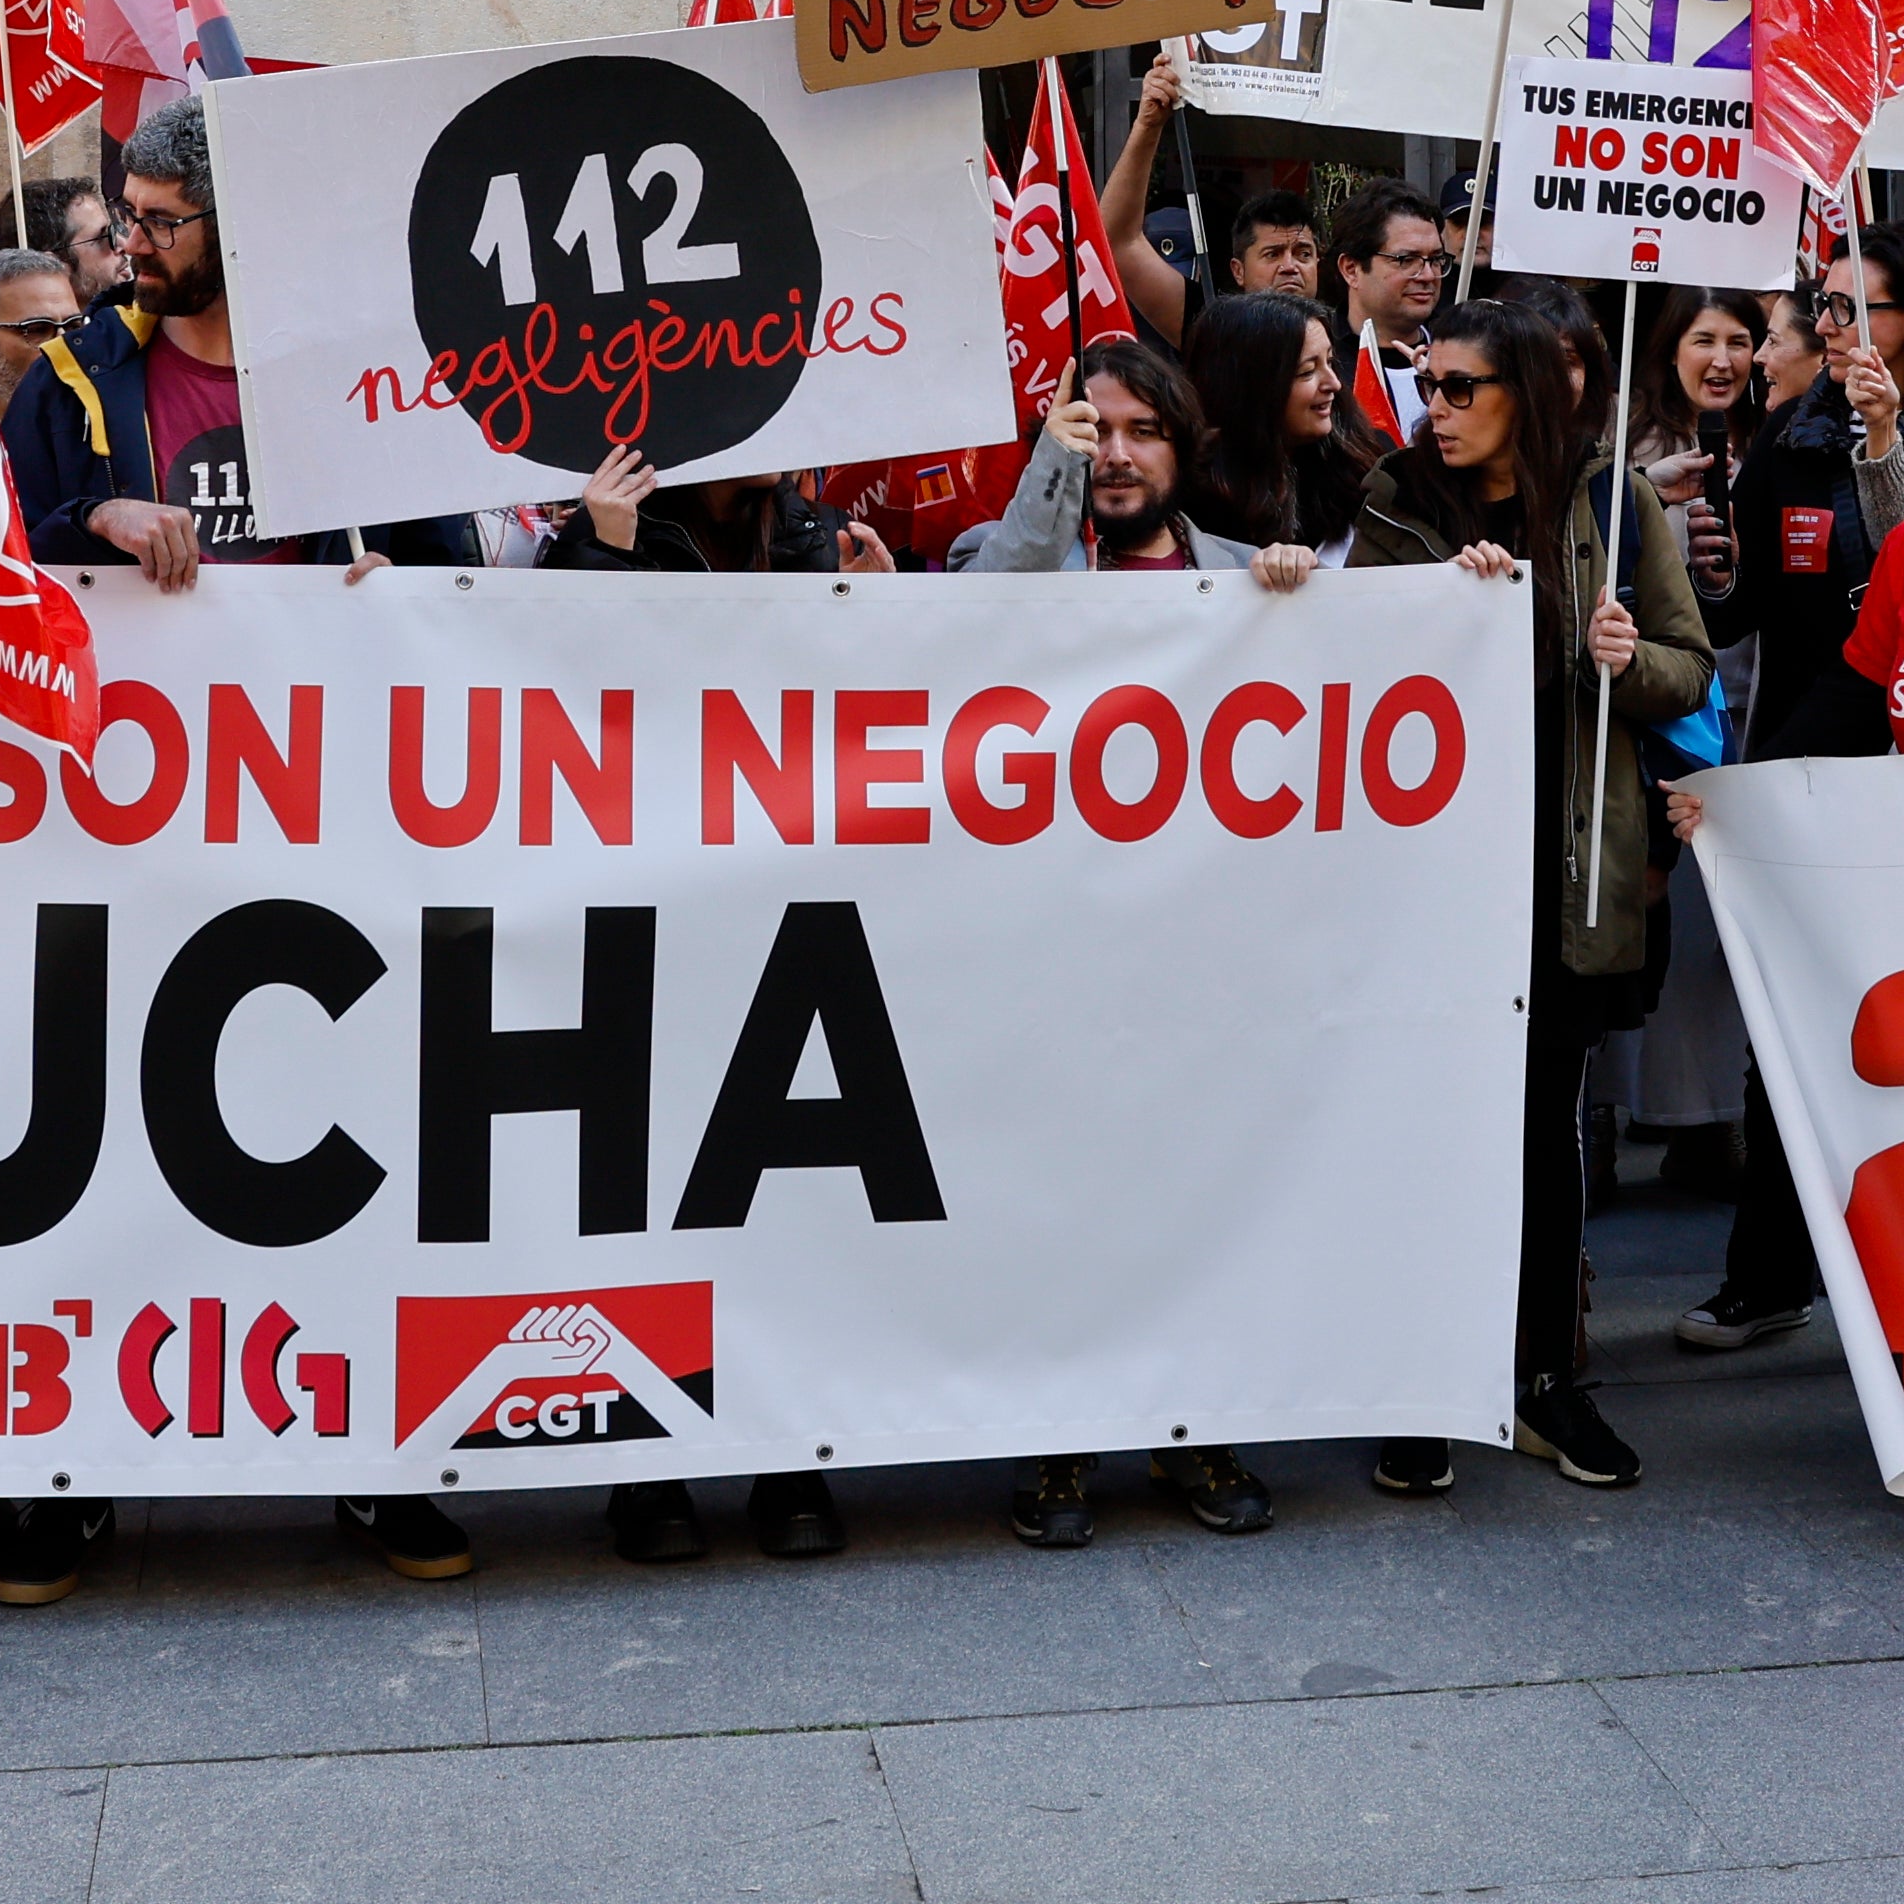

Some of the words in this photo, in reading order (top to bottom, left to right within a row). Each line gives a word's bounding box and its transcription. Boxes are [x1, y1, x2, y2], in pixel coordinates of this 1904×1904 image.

[1273, 72, 1284, 82] Fax
[1523, 84, 1576, 115] TUS
[1553, 123, 1626, 174] NO
[1641, 130, 1742, 181] SON
[470, 142, 741, 307] 112
[1533, 175, 1584, 214] UN
[1596, 178, 1767, 226] NEGOCIO
[1631, 258, 1660, 273] CGT
[346, 287, 909, 455] negligències
[190, 461, 253, 507] 11
[386, 686, 636, 847] UN
[700, 673, 1468, 847] NEGOCIO
[116, 1294, 350, 1440] CIG
[493, 1387, 620, 1443] CGT
